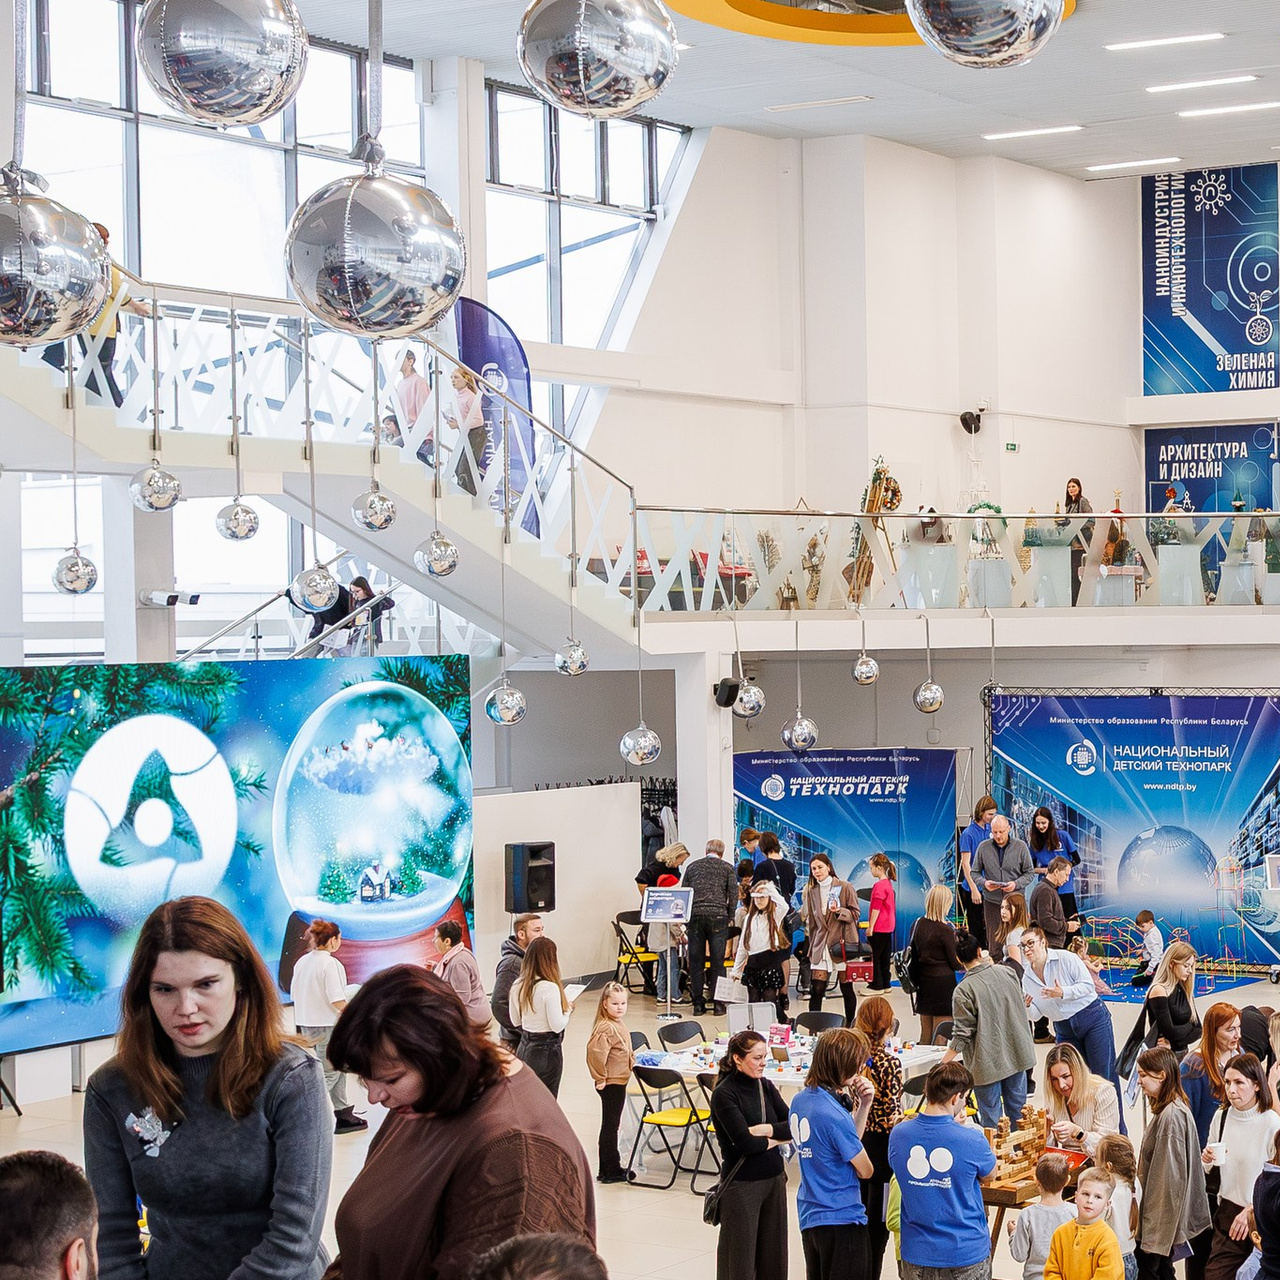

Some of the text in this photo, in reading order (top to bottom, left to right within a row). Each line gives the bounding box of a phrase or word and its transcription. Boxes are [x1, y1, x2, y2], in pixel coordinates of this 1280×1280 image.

[1216, 352, 1275, 371] ЗЕЛЕНАЯ
[1229, 370, 1276, 389] ХИМИЯ
[1159, 442, 1248, 461] АРХИТЕКТУРА
[1160, 458, 1223, 481] И ДИЗАЙН
[1049, 716, 1249, 726] Министерство образования Республики Беларусь
[1113, 744, 1229, 759] НАЦИОНАЛЬНЫЙ
[799, 756, 844, 764] образования
[846, 756, 887, 764] Республики
[1113, 759, 1232, 772] ДЕТСКИЙ ТЕХНОПАРК
[790, 775, 909, 785] НАЦИОНАЛЬНЫЙ ДЕТСКИЙ
[1143, 782, 1197, 792] www.ndtp.by
[789, 783, 909, 797] ТЕХНОПАРК
